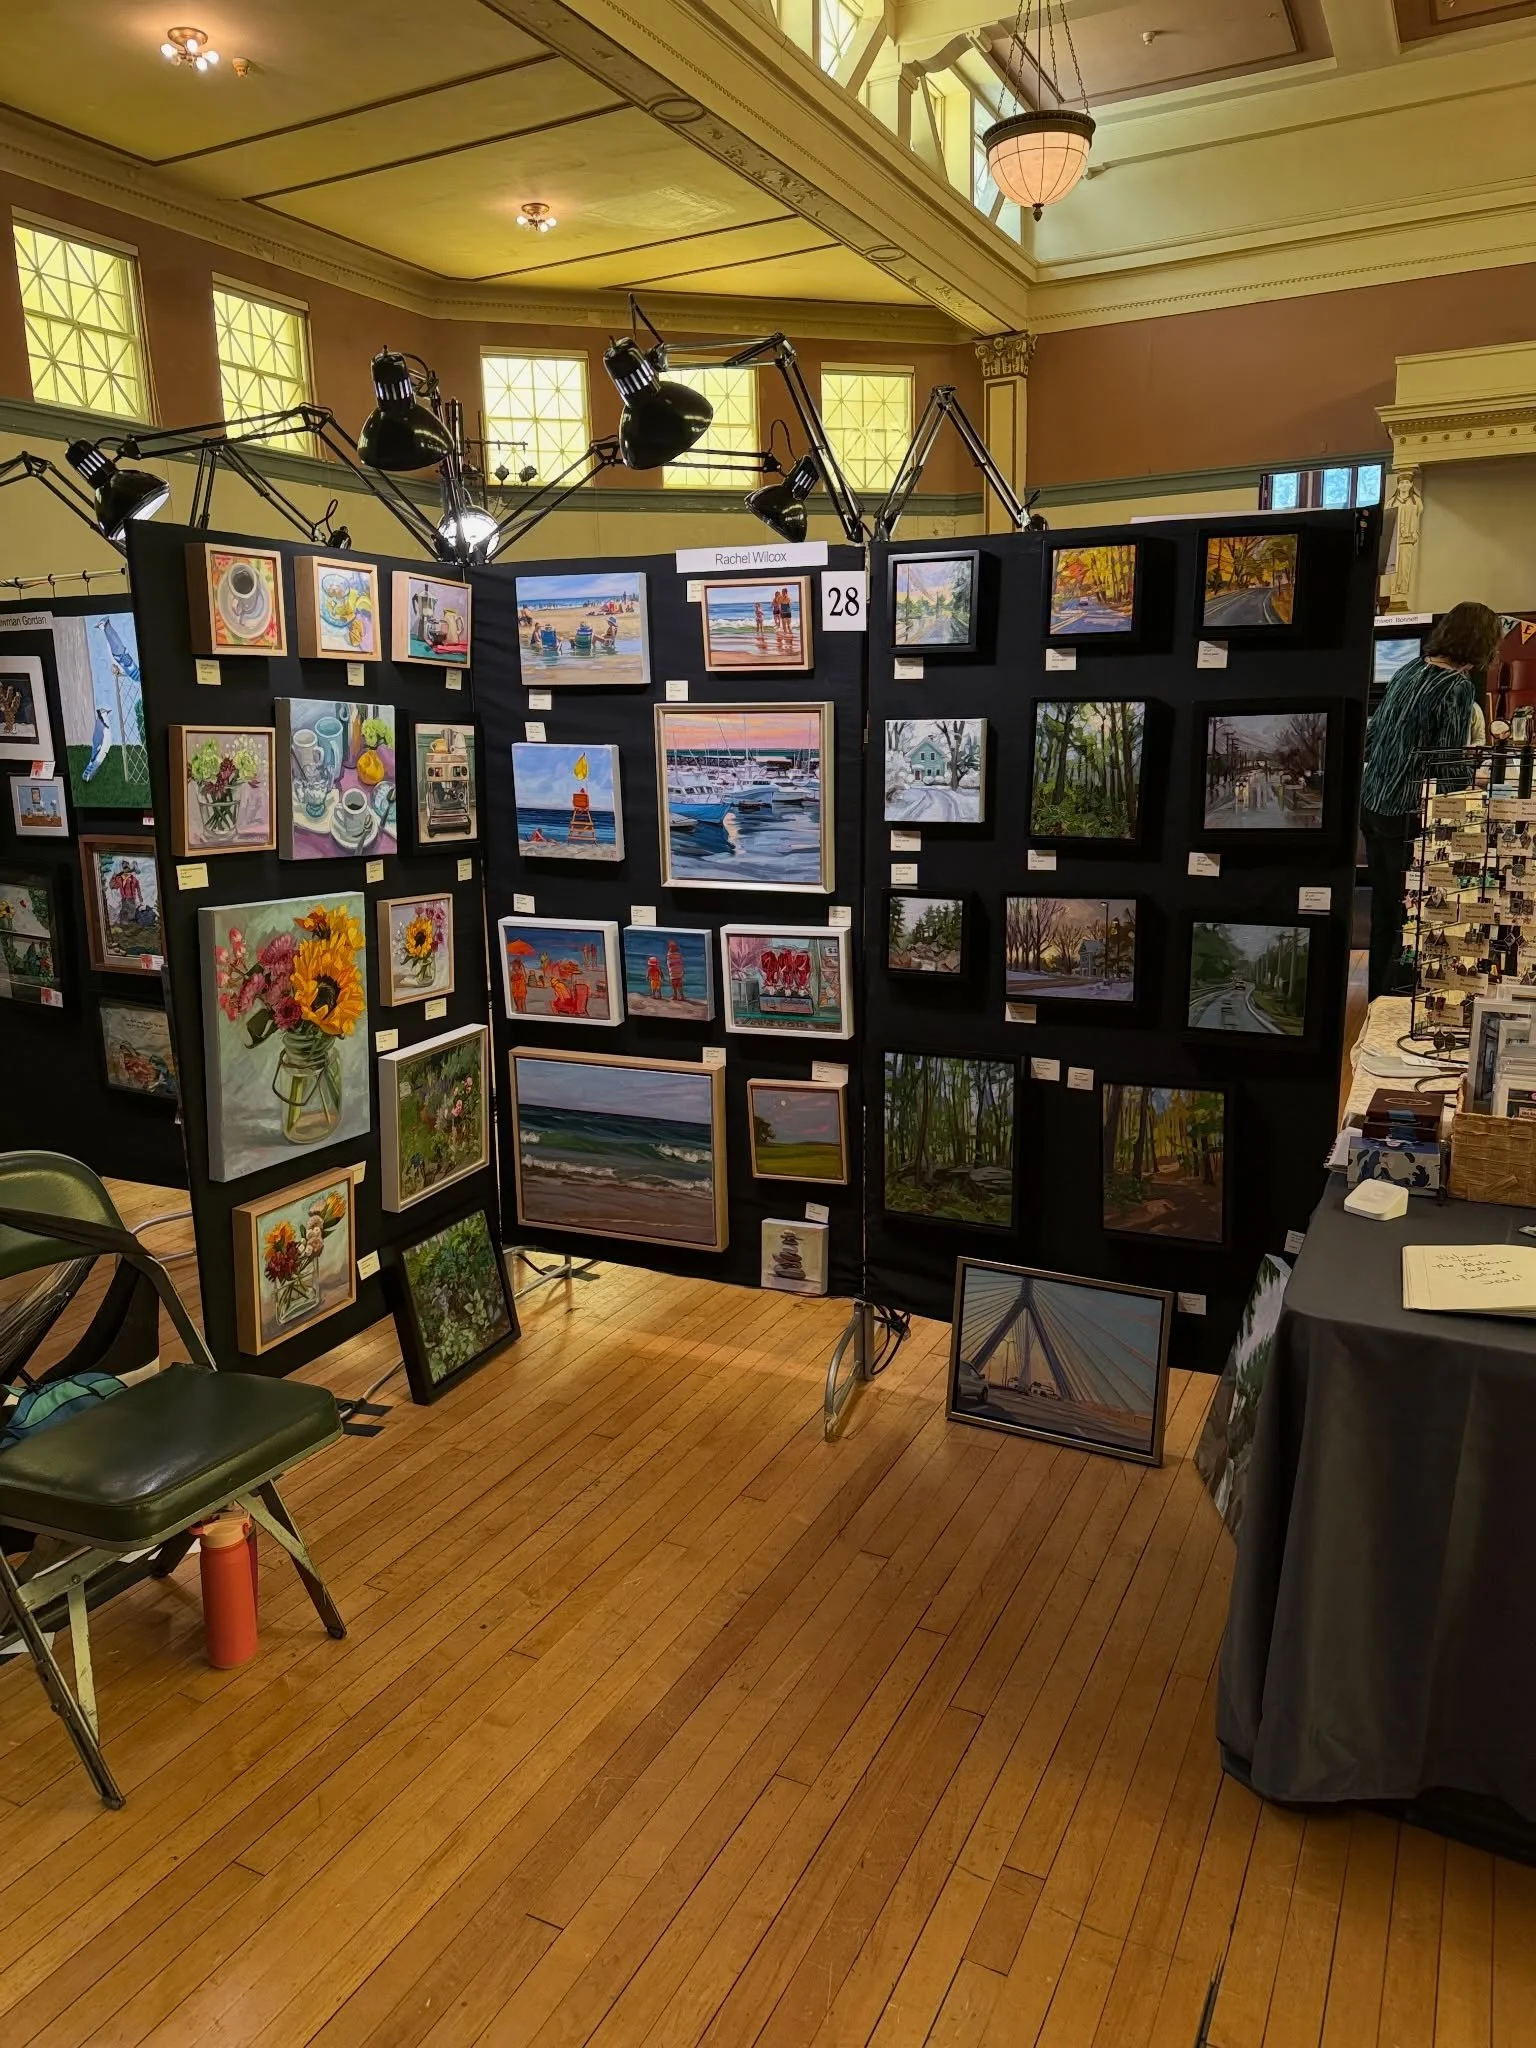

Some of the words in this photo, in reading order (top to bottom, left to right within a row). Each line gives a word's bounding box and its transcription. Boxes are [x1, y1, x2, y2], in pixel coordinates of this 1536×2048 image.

[715, 553, 751, 566] Rachel
[752, 550, 787, 563] Wilcox
[828, 586, 860, 616] 28
